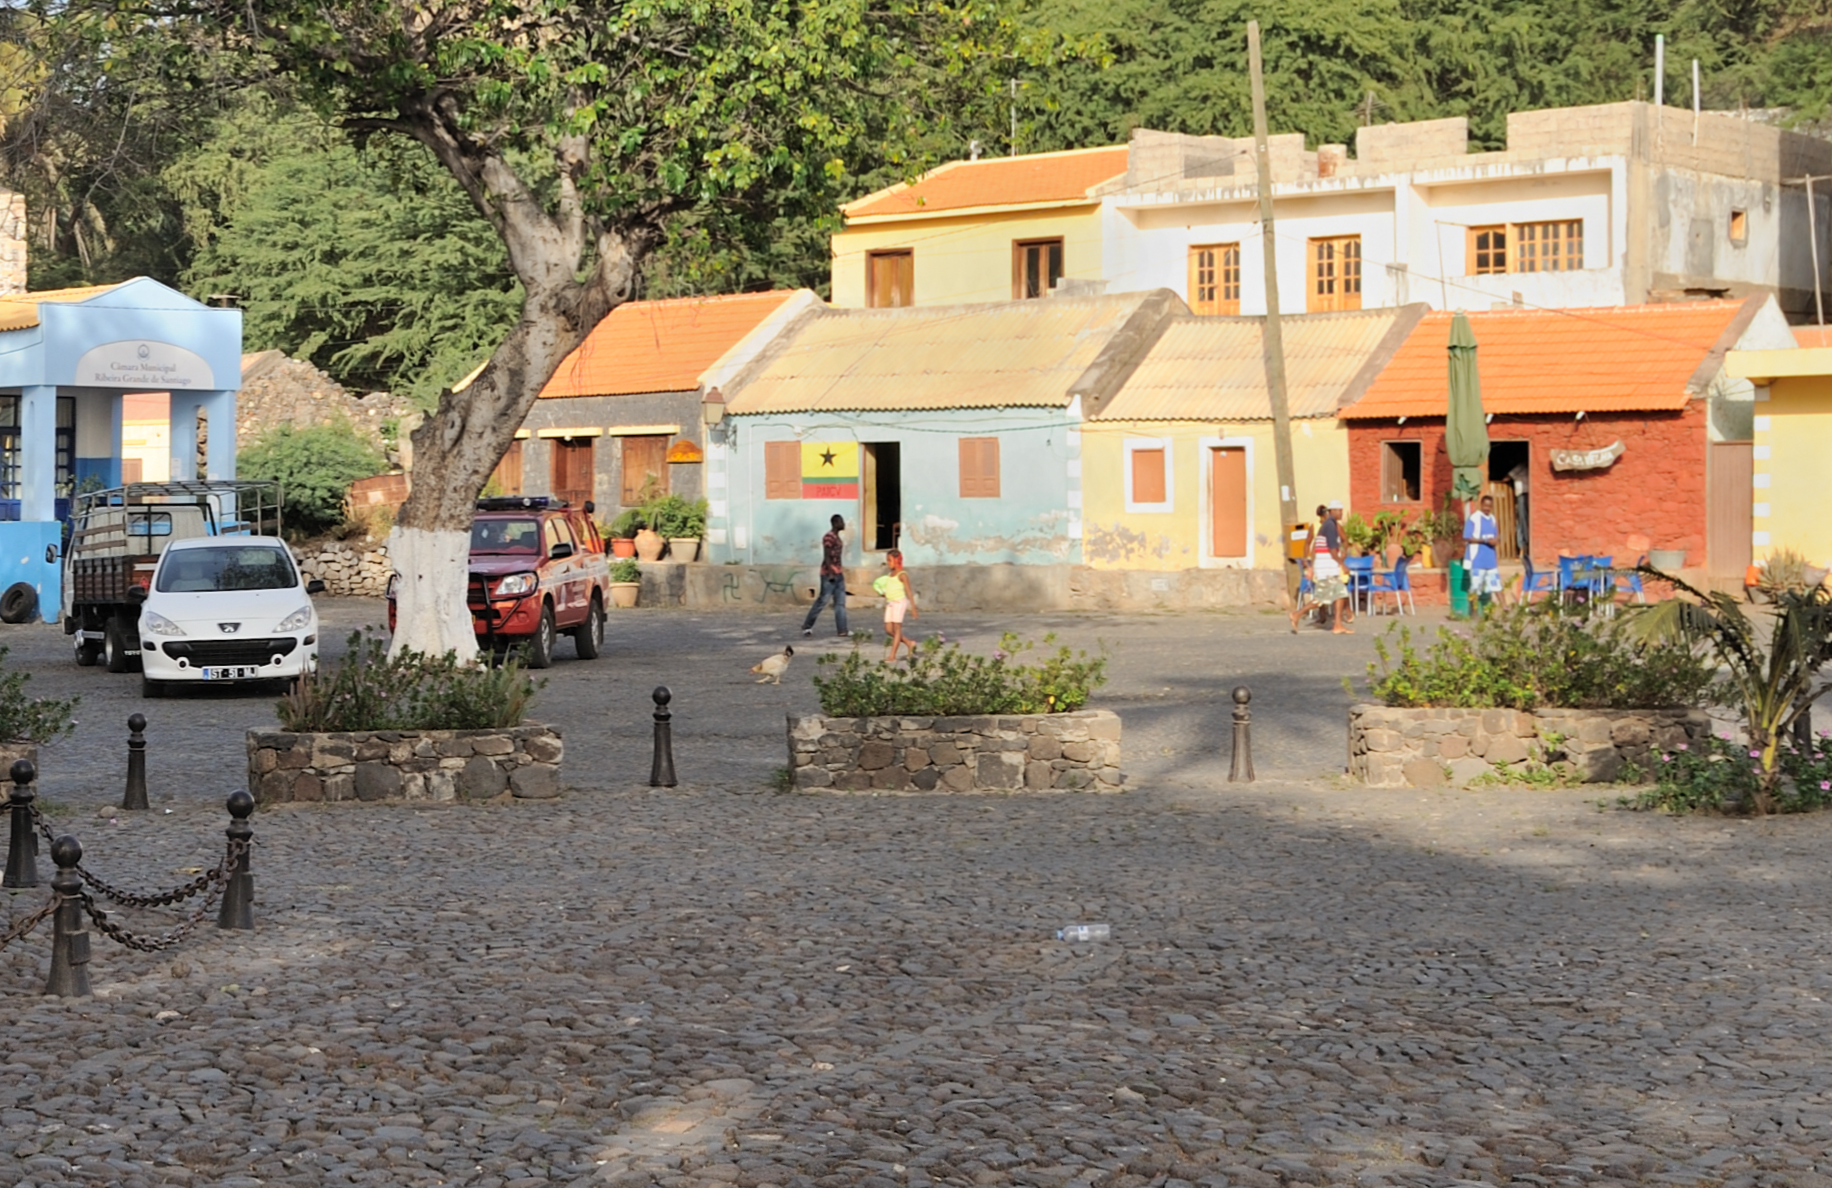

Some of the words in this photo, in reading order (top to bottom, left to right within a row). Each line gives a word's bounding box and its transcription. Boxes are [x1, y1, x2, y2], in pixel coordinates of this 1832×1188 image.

[110, 362, 138, 371] Câmara
[140, 363, 176, 374] Municipal
[94, 373, 121, 382] Ribeira
[122, 374, 150, 383] Grande
[151, 375, 159, 383] de
[160, 376, 191, 386] Santiago
